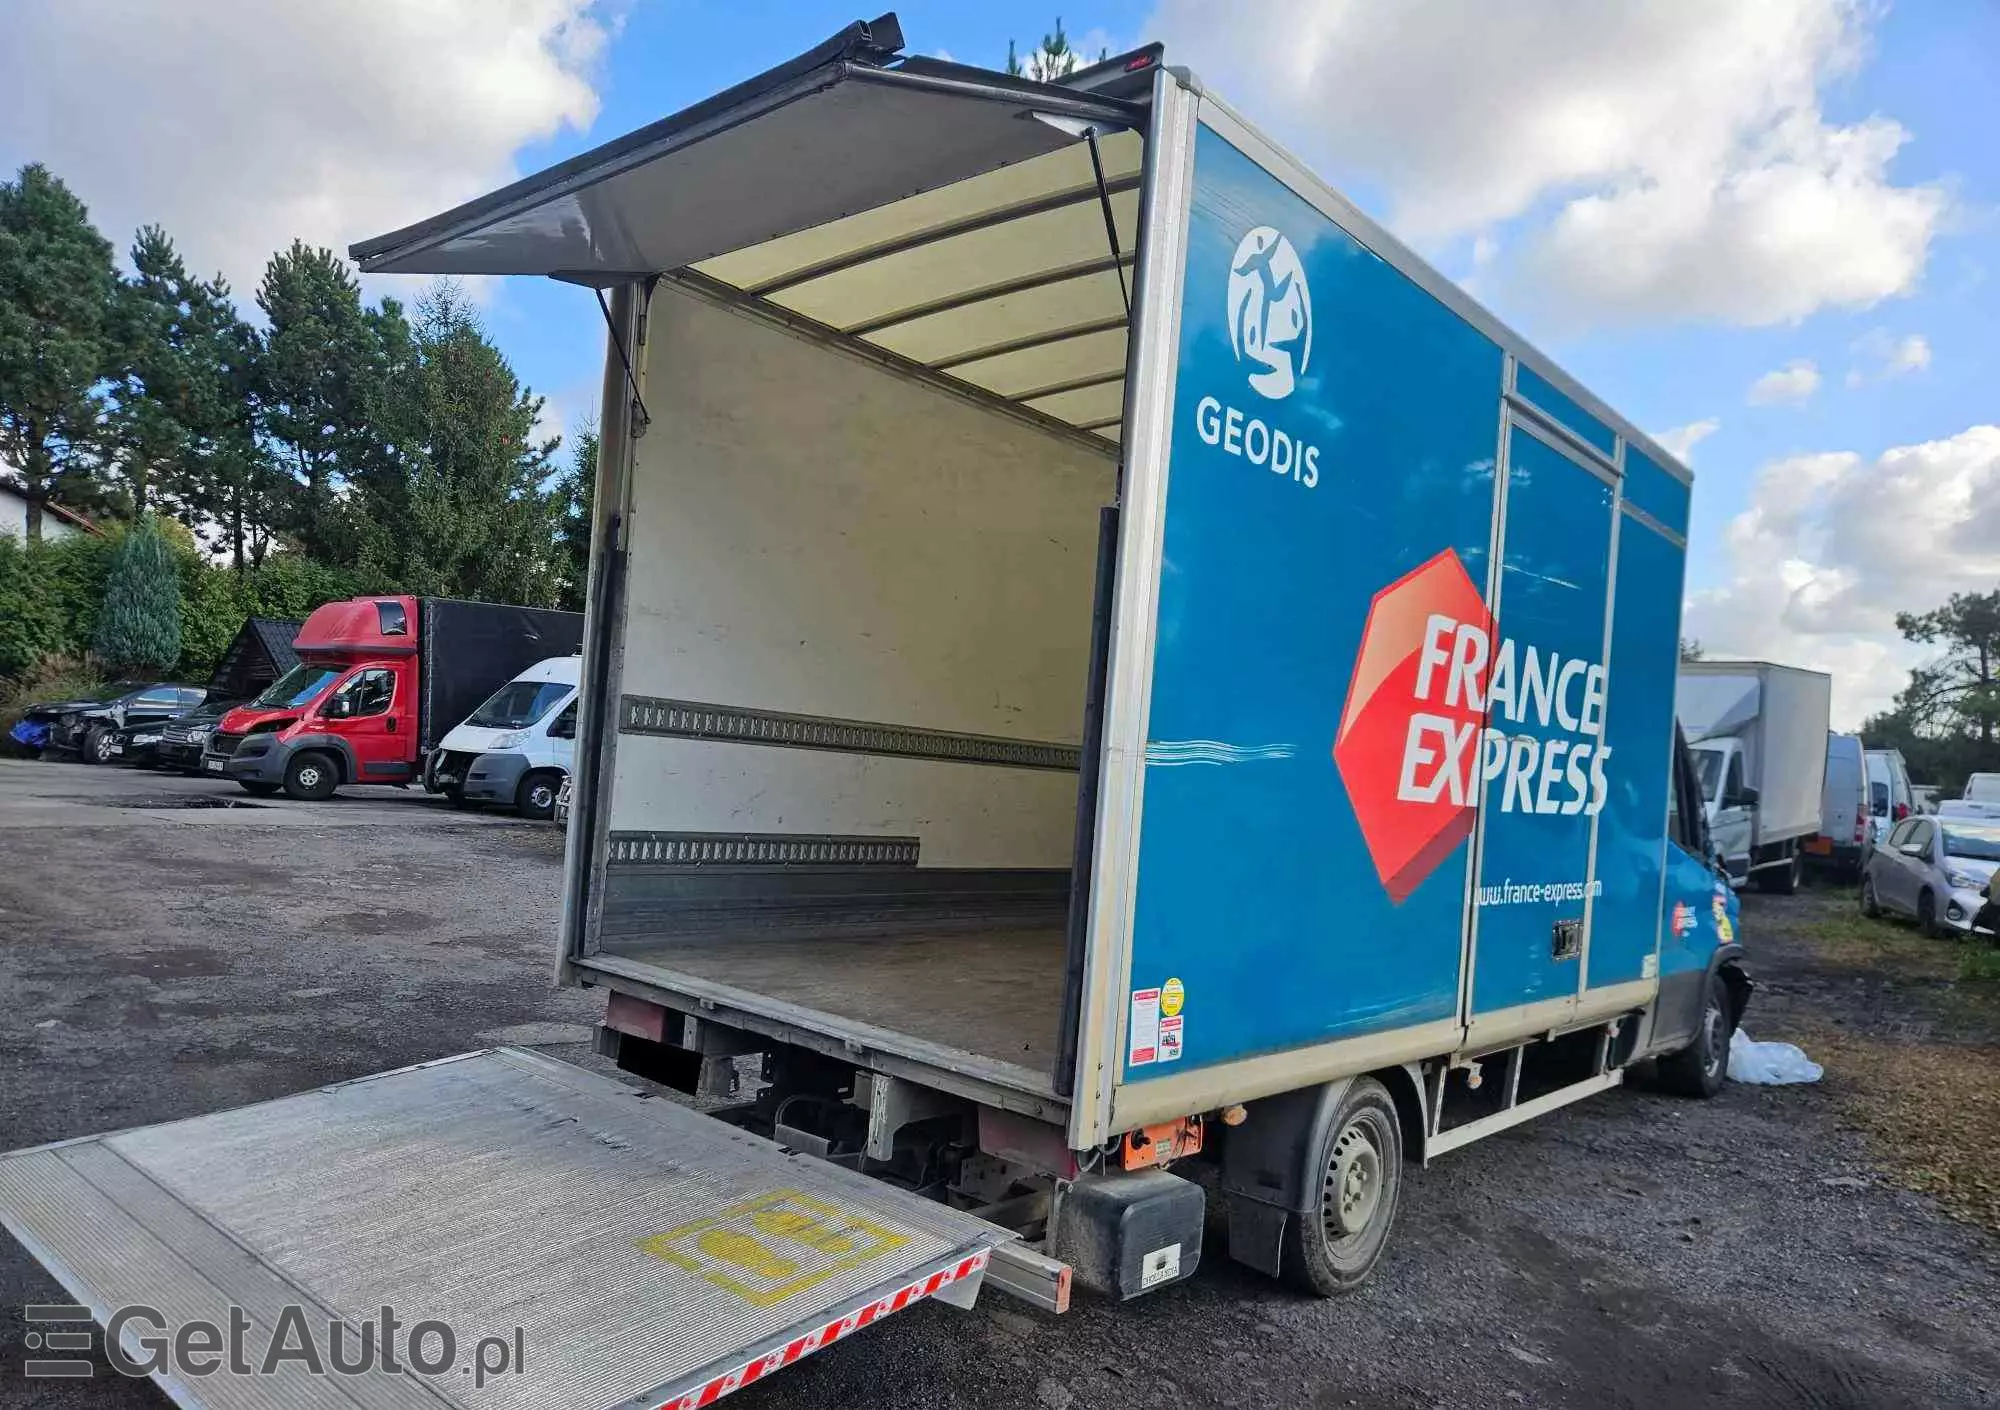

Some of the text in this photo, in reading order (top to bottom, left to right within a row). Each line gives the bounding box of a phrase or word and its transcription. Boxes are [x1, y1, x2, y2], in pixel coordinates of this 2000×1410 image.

[1197, 396, 1320, 488] GEODIS
[1414, 614, 1606, 735] FRANCE
[1397, 714, 1612, 816] EXPRESS
